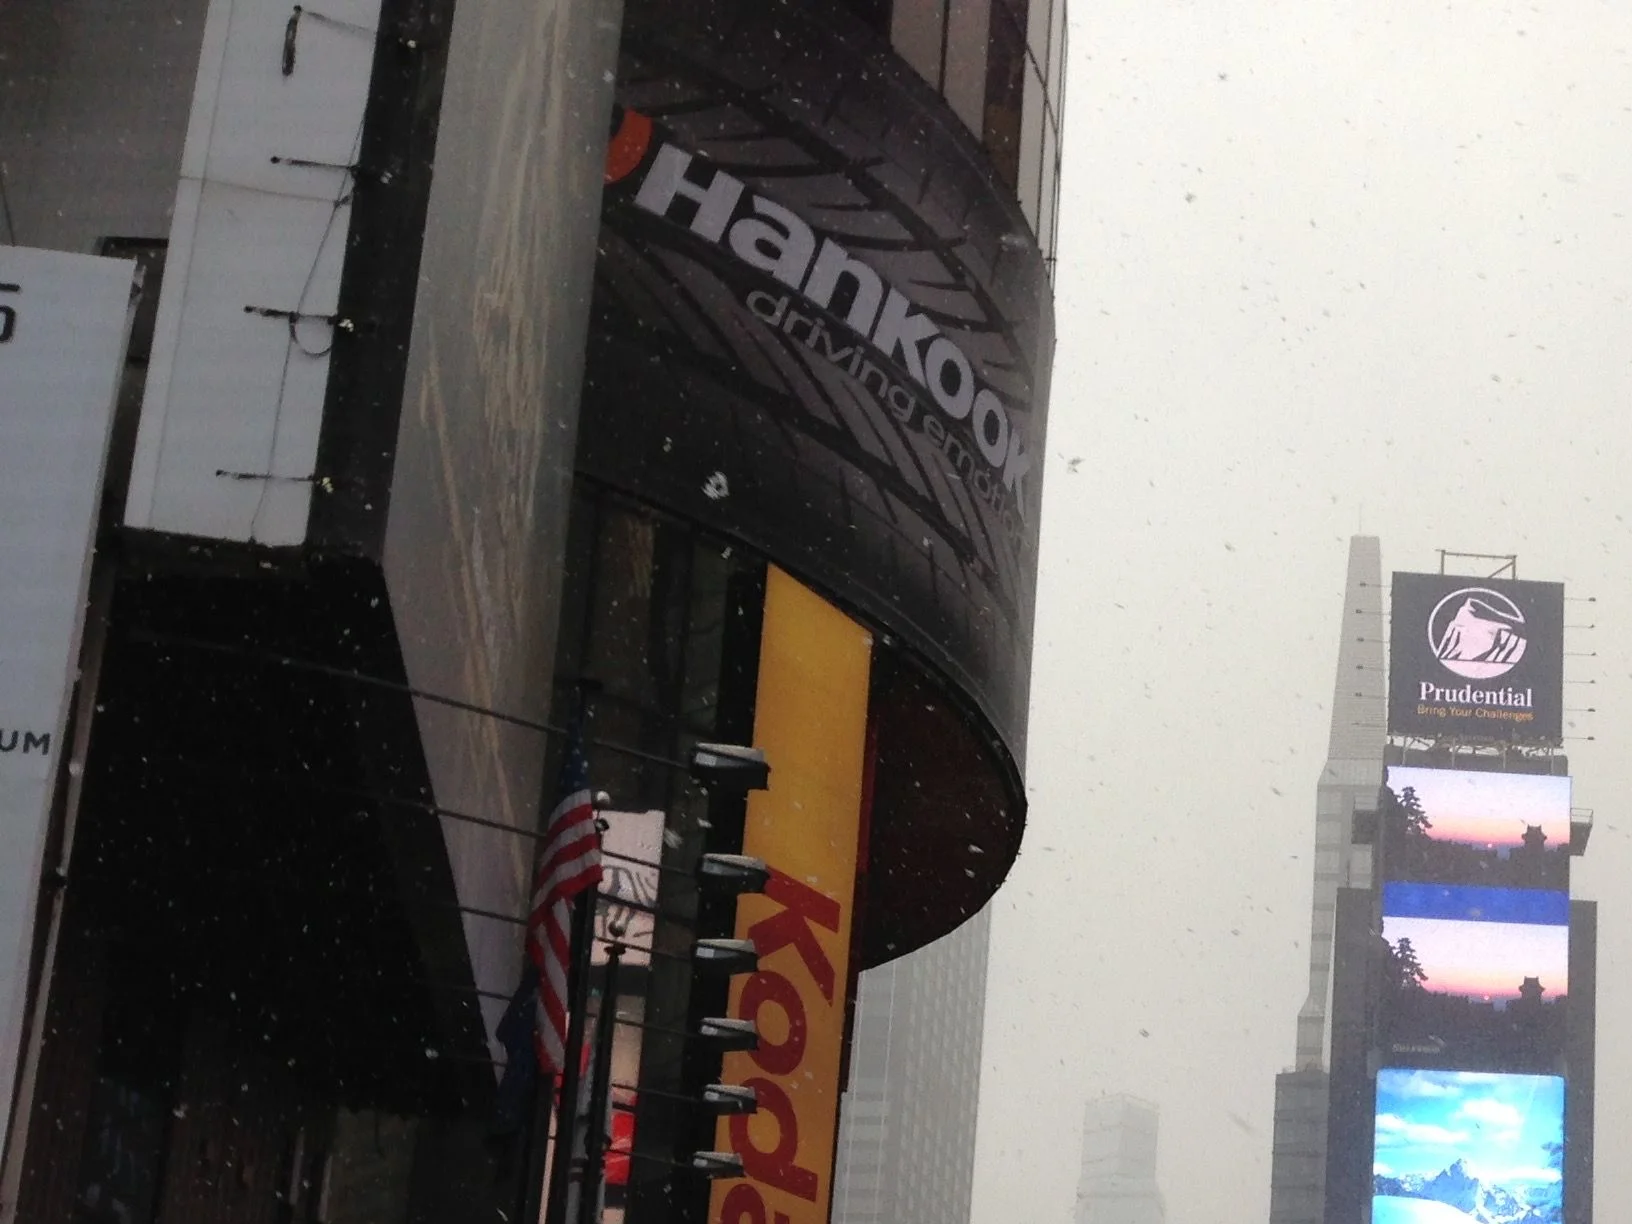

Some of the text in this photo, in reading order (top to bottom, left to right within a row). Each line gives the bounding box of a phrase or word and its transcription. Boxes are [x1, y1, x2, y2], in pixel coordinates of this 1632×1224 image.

[635, 142, 1030, 515] Hankook
[746, 290, 916, 423] driving
[1417, 704, 1535, 722] Bring Your Challenges
[1420, 681, 1533, 707] Prudential
